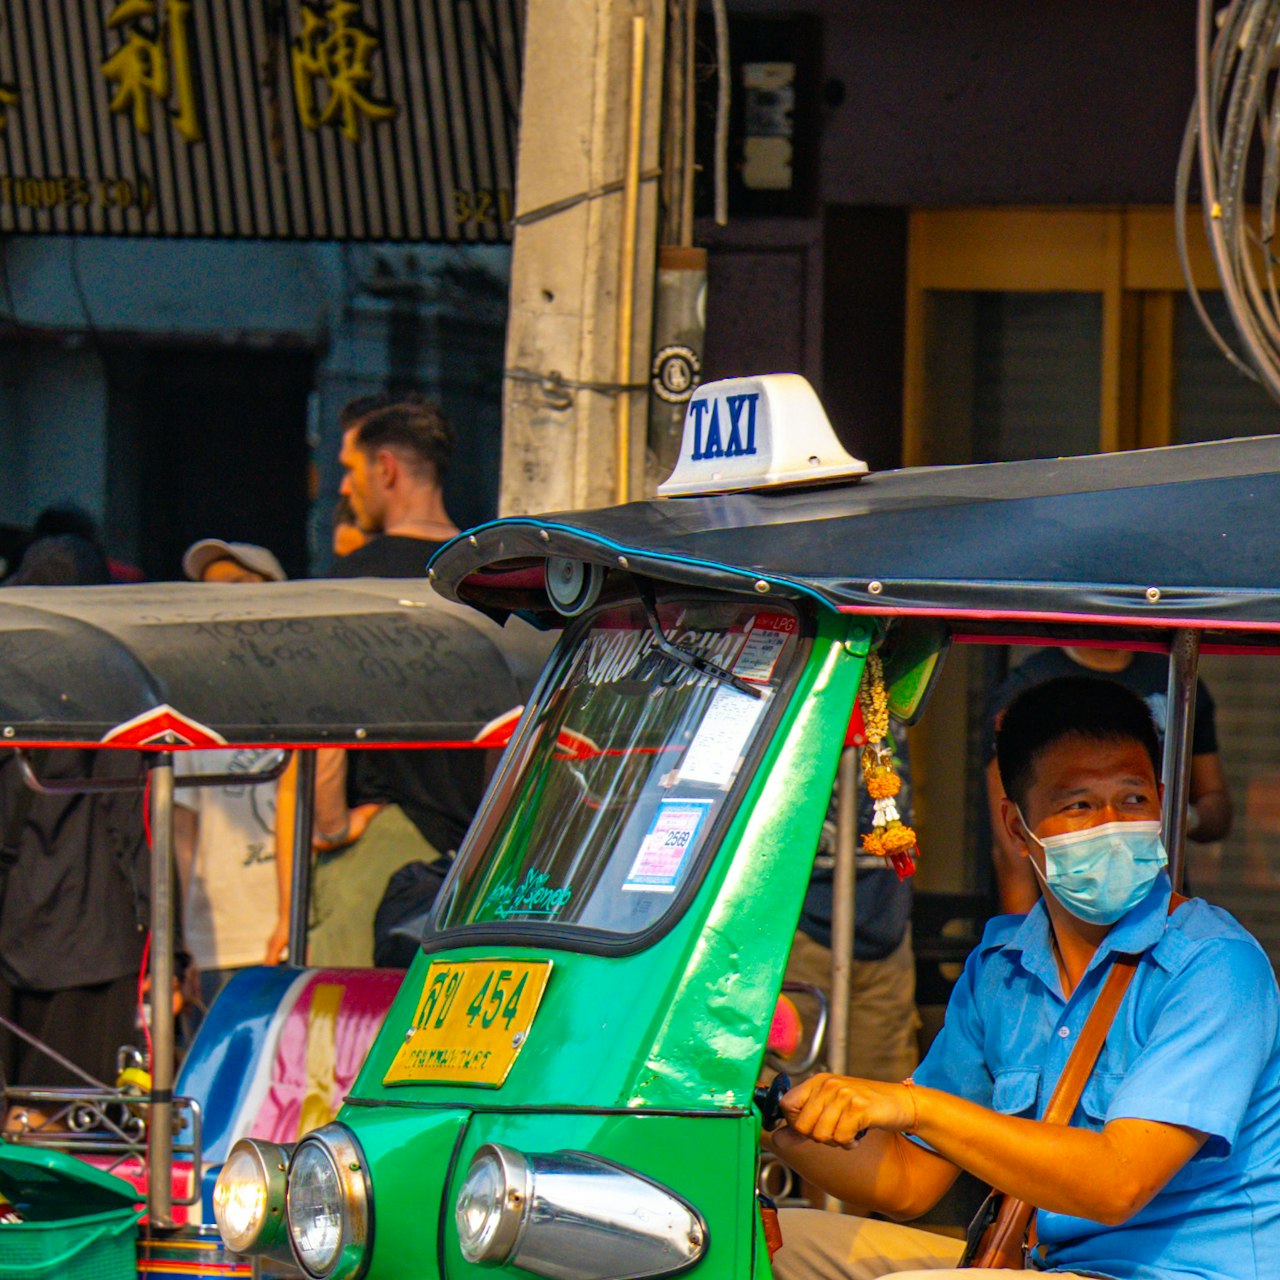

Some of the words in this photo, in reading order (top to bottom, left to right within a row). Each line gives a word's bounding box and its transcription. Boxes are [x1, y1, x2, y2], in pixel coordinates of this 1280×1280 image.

[690, 393, 760, 461] TAXI
[772, 615, 796, 632] LPG
[466, 968, 530, 1031] 454
